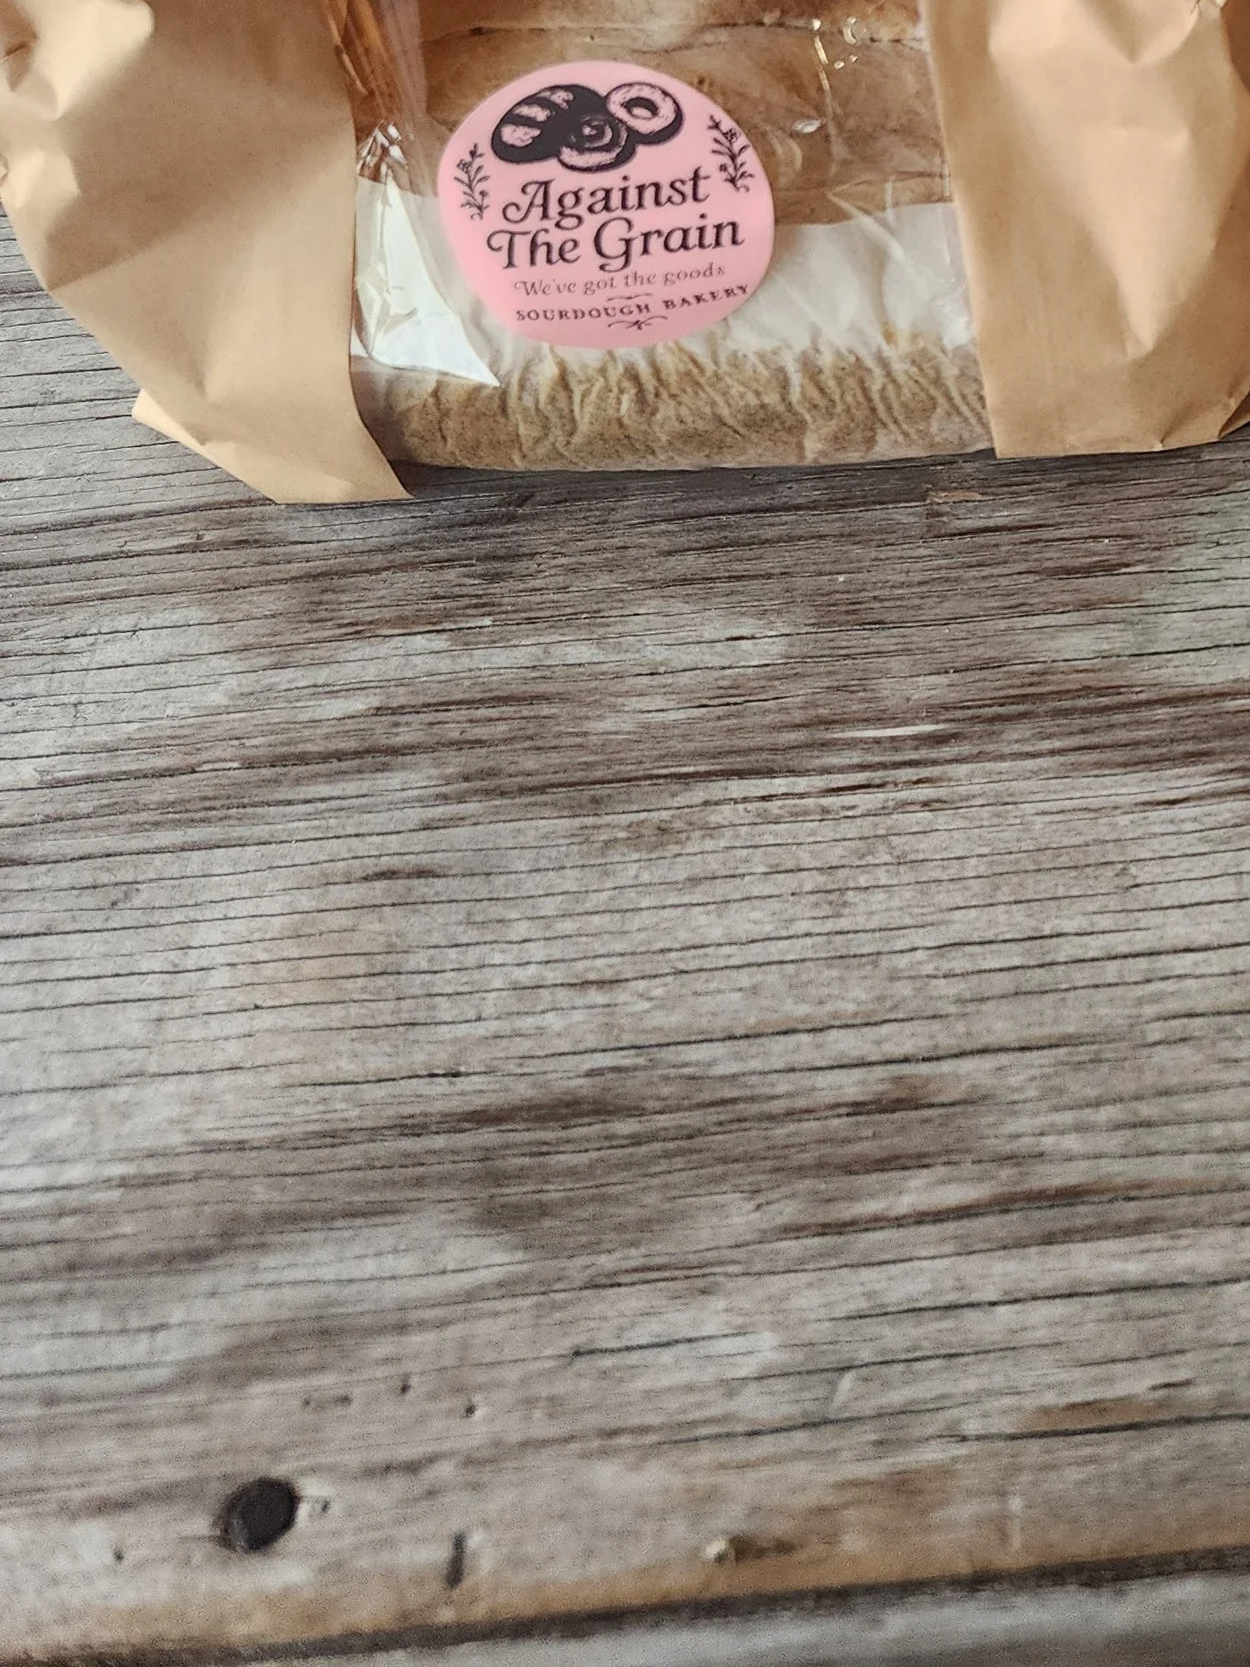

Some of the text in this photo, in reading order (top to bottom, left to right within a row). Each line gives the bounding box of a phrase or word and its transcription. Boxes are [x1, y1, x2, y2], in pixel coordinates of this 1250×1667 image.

[501, 166, 711, 231] Against
[486, 212, 746, 273] The Grain
[513, 263, 726, 297] We've got the goods
[516, 283, 750, 322] SOURDOUGH BAKERY
